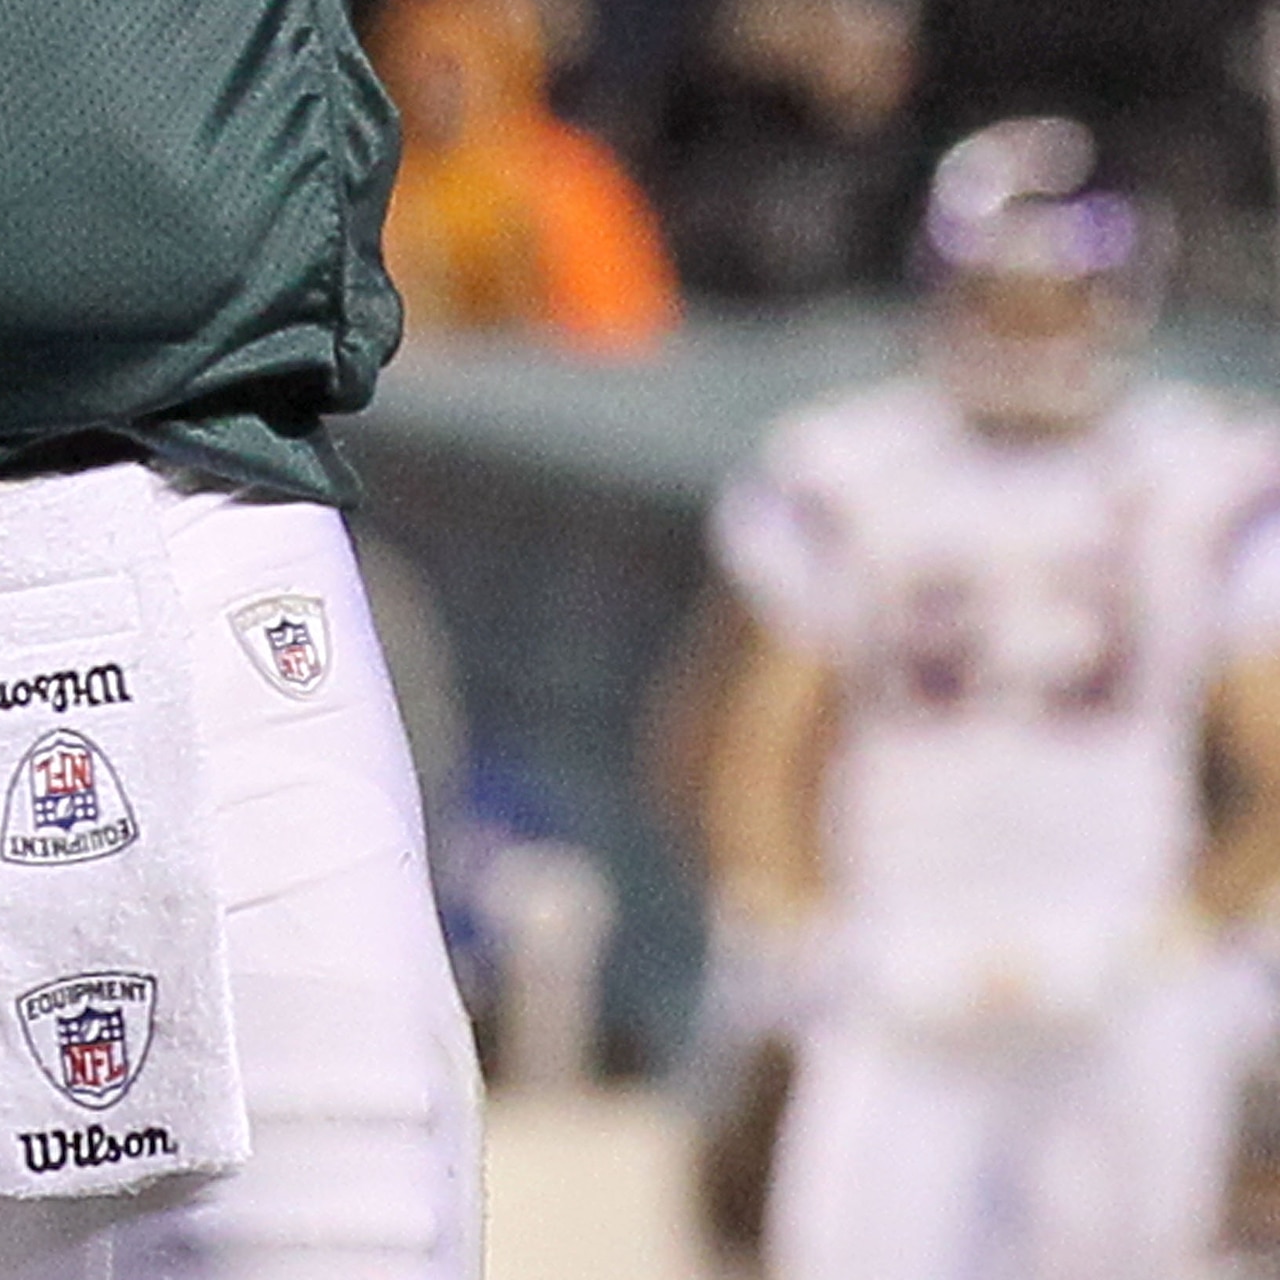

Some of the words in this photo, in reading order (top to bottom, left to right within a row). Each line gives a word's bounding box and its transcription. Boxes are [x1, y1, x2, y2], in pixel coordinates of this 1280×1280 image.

[35, 750, 94, 794] NFL
[9, 817, 131, 858] EQUIPMENT
[25, 980, 146, 1021] EQUIPMENT
[64, 1042, 129, 1087] NFL
[18, 1124, 178, 1173] Wilson
